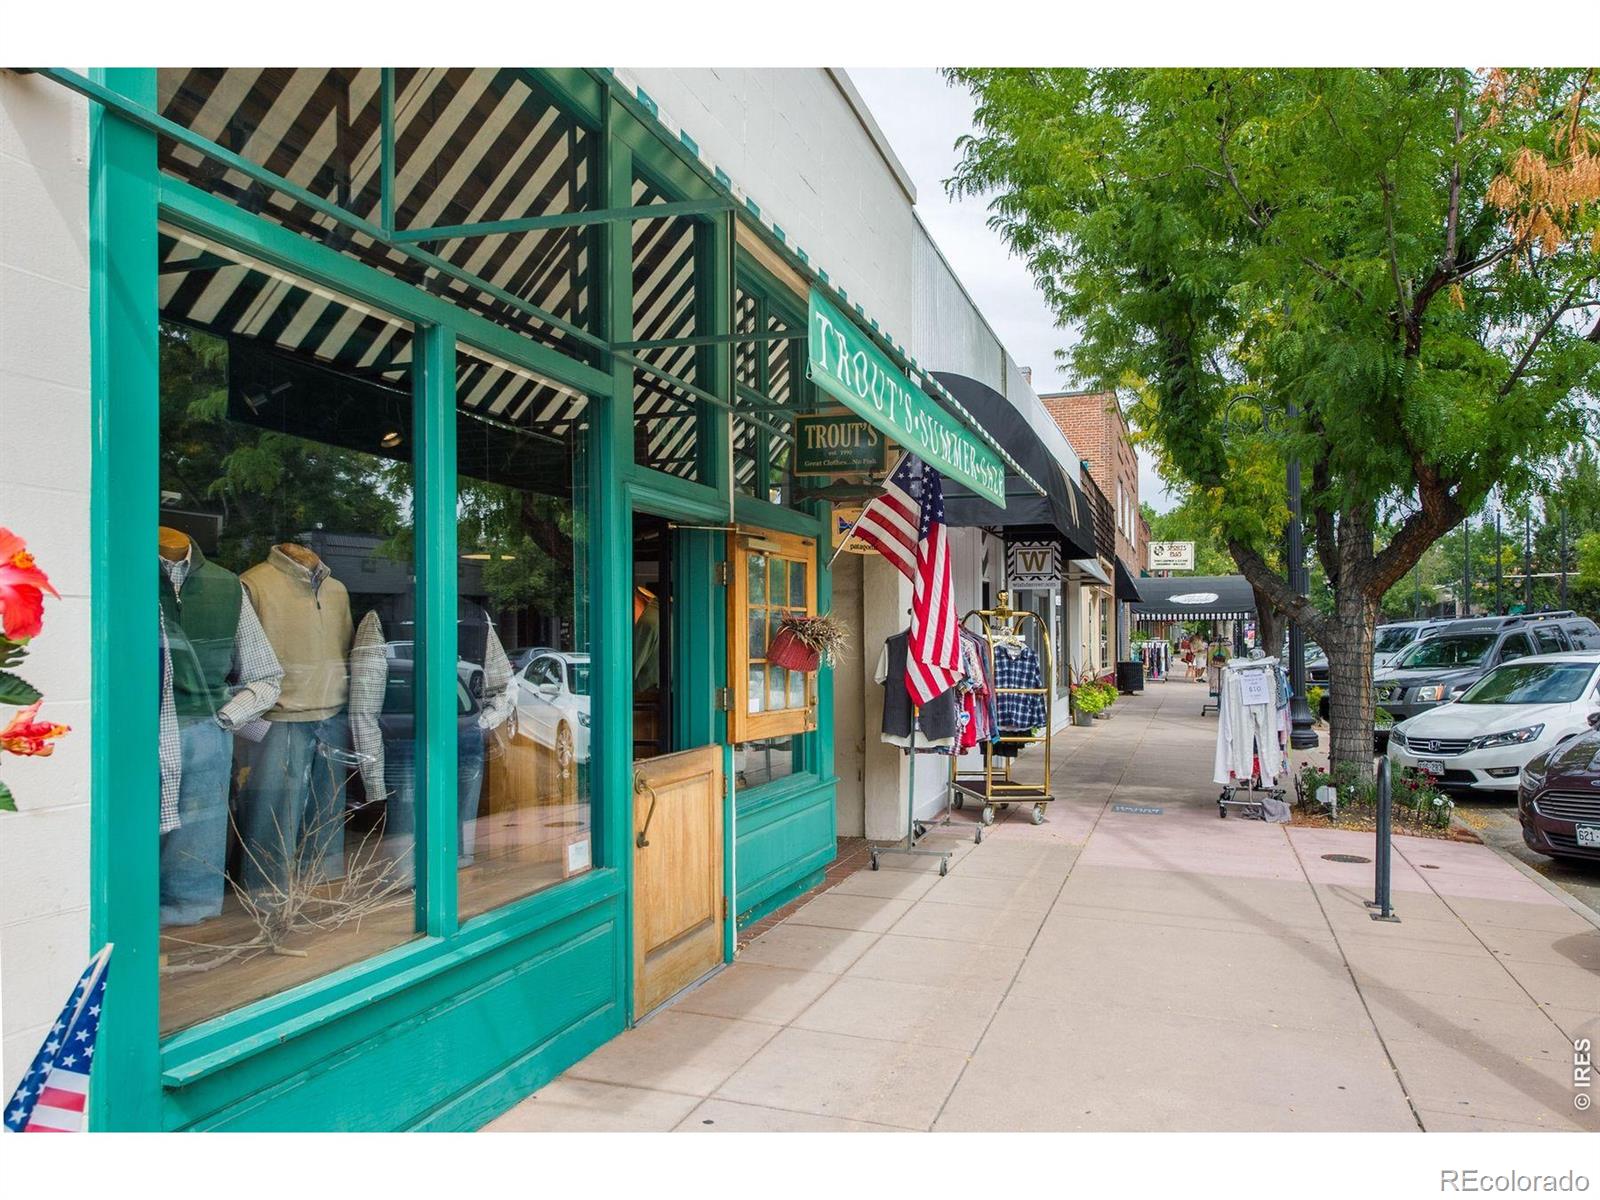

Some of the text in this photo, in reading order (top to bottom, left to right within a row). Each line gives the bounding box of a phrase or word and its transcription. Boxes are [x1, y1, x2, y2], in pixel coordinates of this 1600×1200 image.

[815, 311, 1004, 498] TROUT'S SUMMER SALE
[804, 422, 878, 449] TROUT'S
[1018, 550, 1050, 572] W
